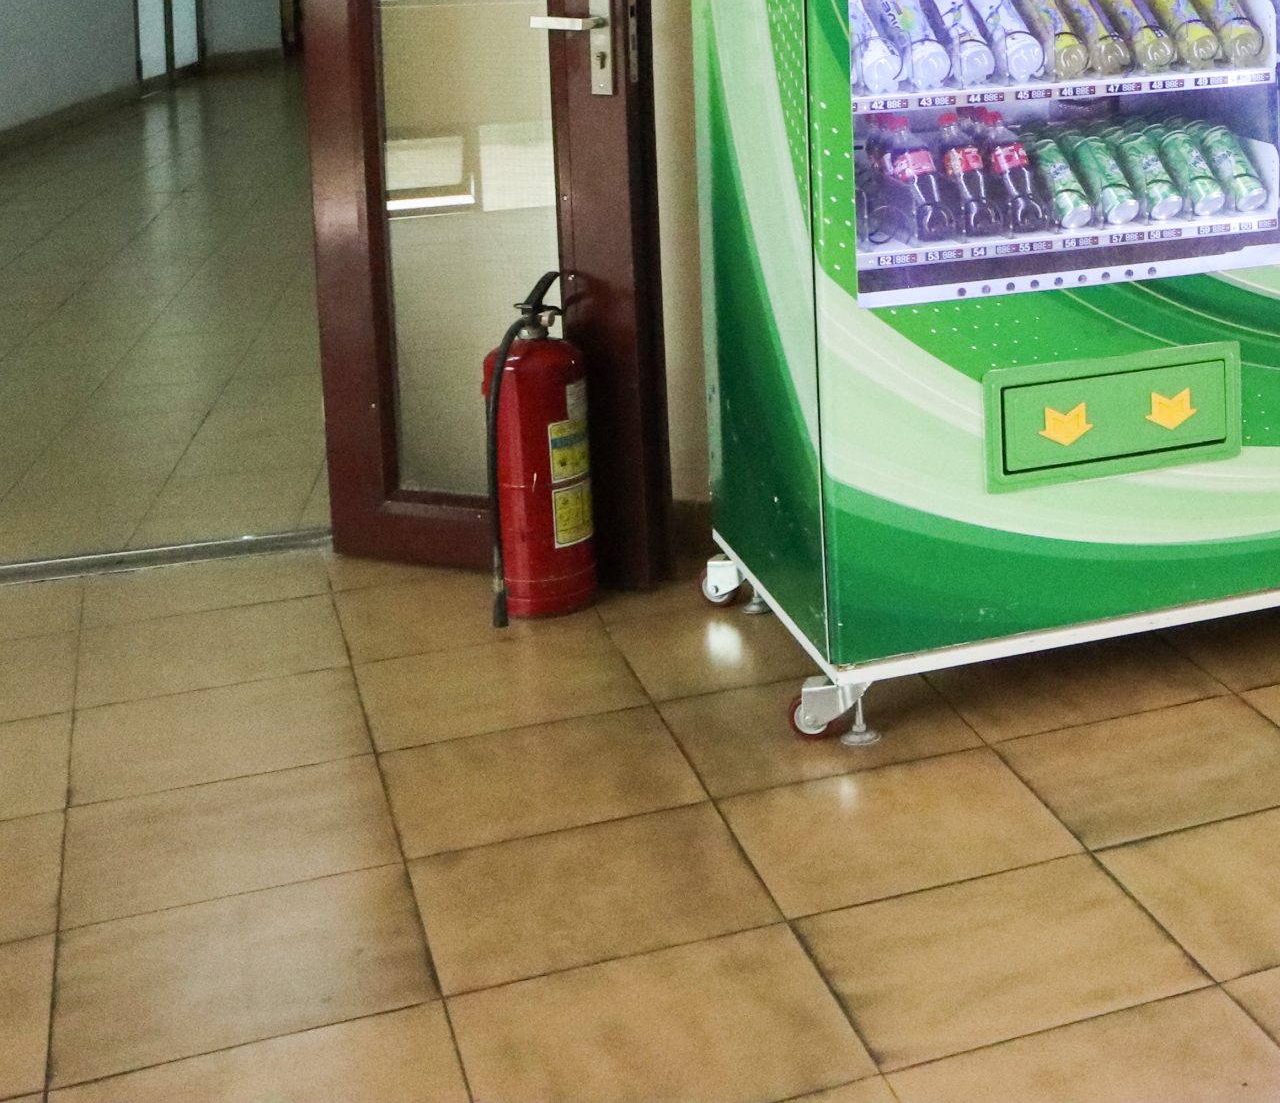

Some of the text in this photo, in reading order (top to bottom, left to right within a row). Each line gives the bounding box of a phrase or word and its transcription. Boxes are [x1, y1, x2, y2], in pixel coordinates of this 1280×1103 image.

[1109, 85, 1119, 93] 47
[1152, 81, 1162, 89] 48
[1062, 88, 1073, 96] 46
[921, 98, 932, 106] 43
[1200, 226, 1210, 234] 59
[1065, 239, 1076, 247] 56
[1112, 235, 1123, 243] 57
[973, 248, 984, 256] 54
[1019, 244, 1030, 252] 55
[928, 252, 939, 260] 53
[880, 257, 892, 265] 52
